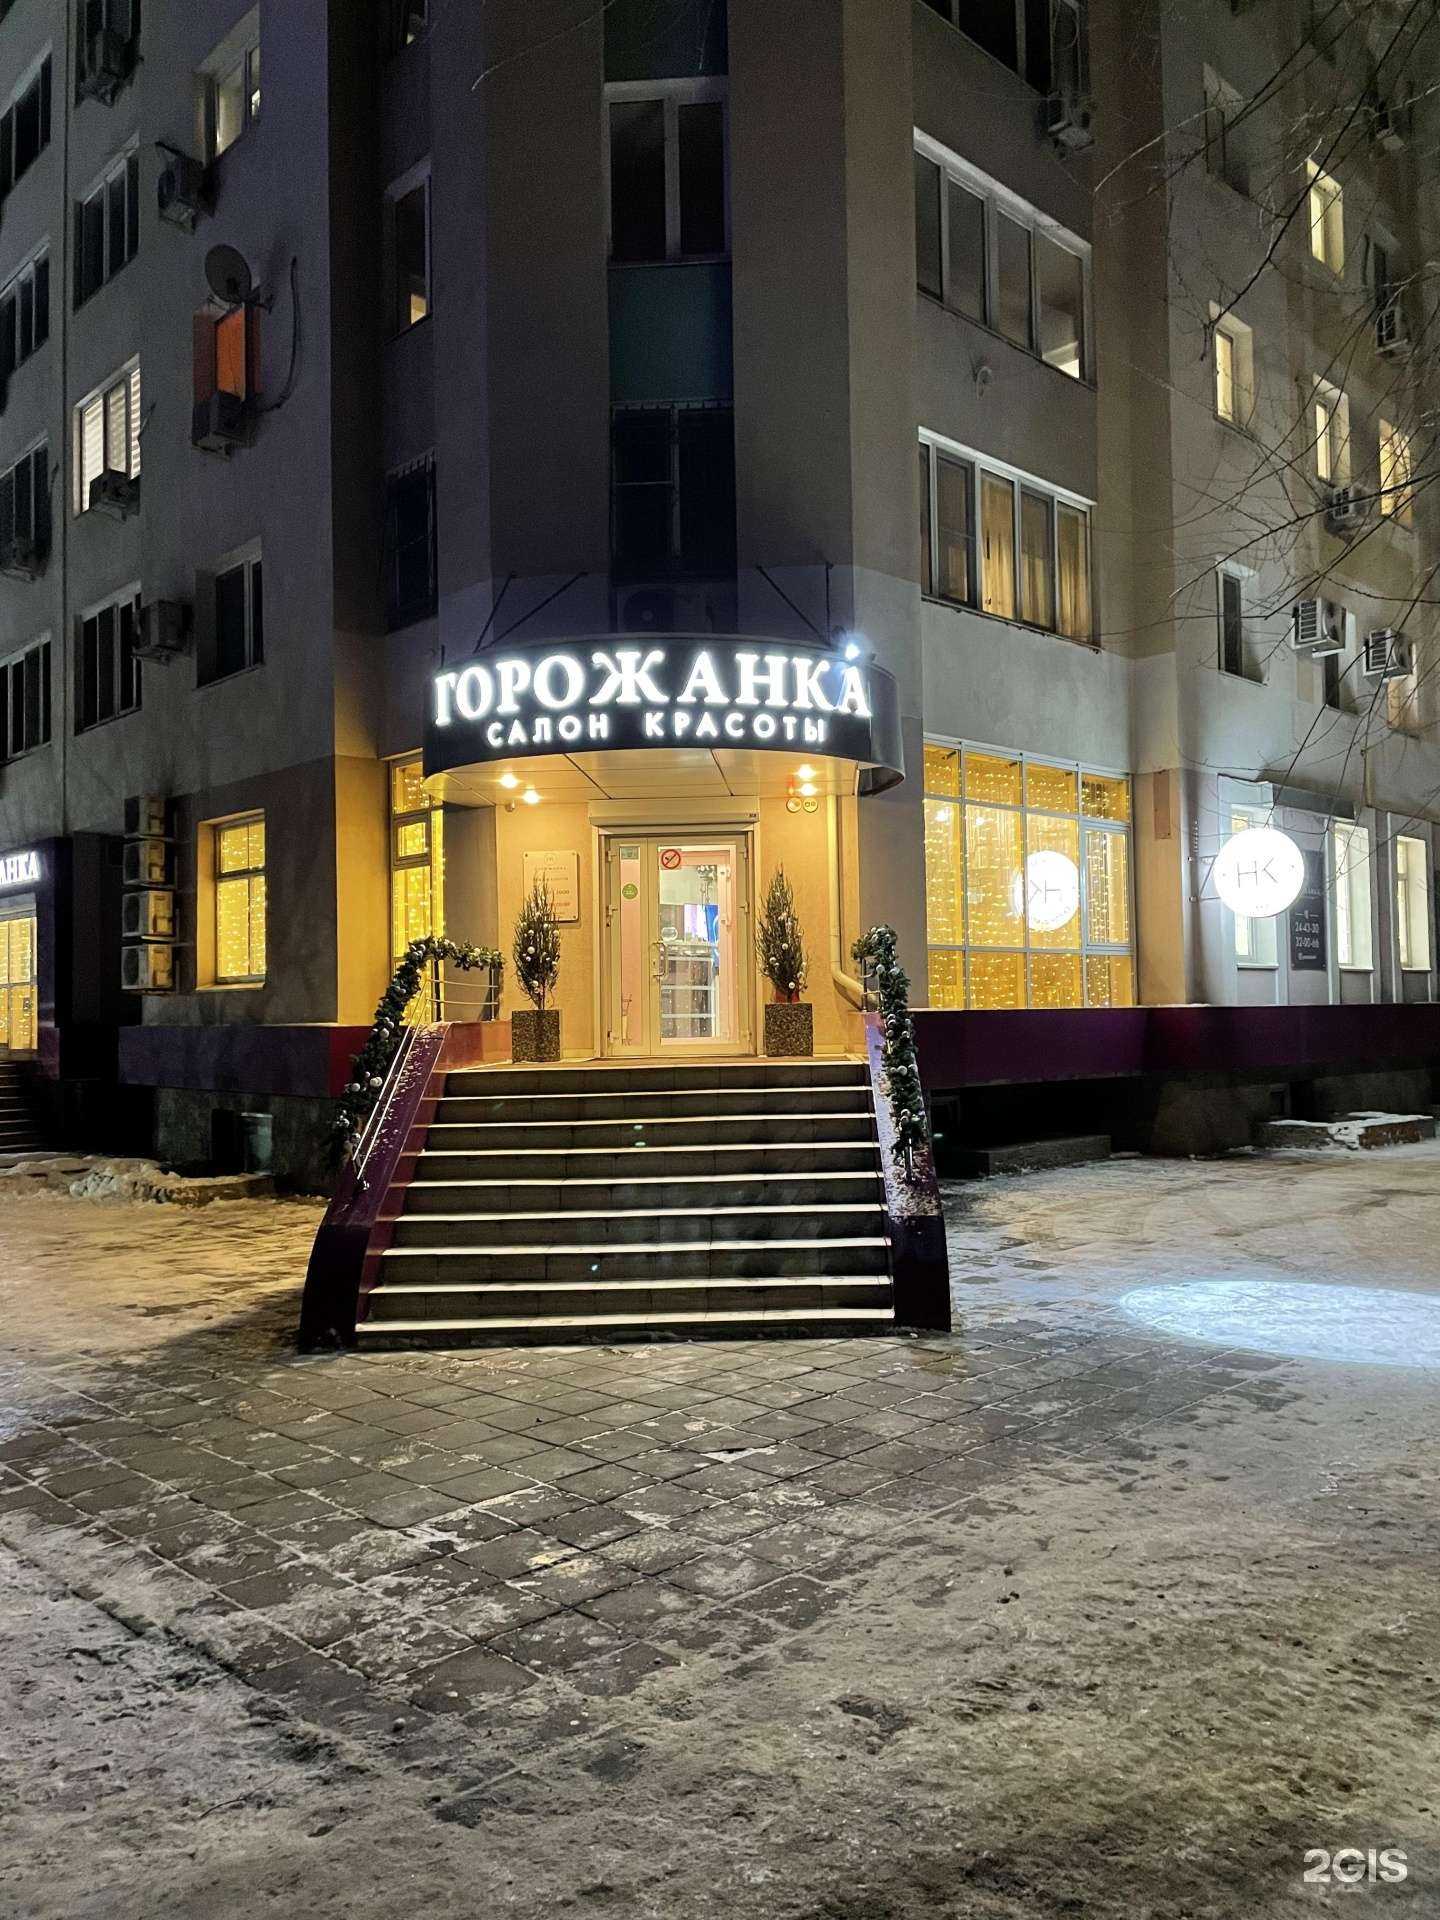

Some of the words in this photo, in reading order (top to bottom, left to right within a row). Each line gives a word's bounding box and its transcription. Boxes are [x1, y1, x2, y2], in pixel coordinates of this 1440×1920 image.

[435, 650, 872, 727] ГОРОЖАНКА
[487, 717, 609, 747] САЛОН
[644, 712, 828, 743] КРАСОТЫ
